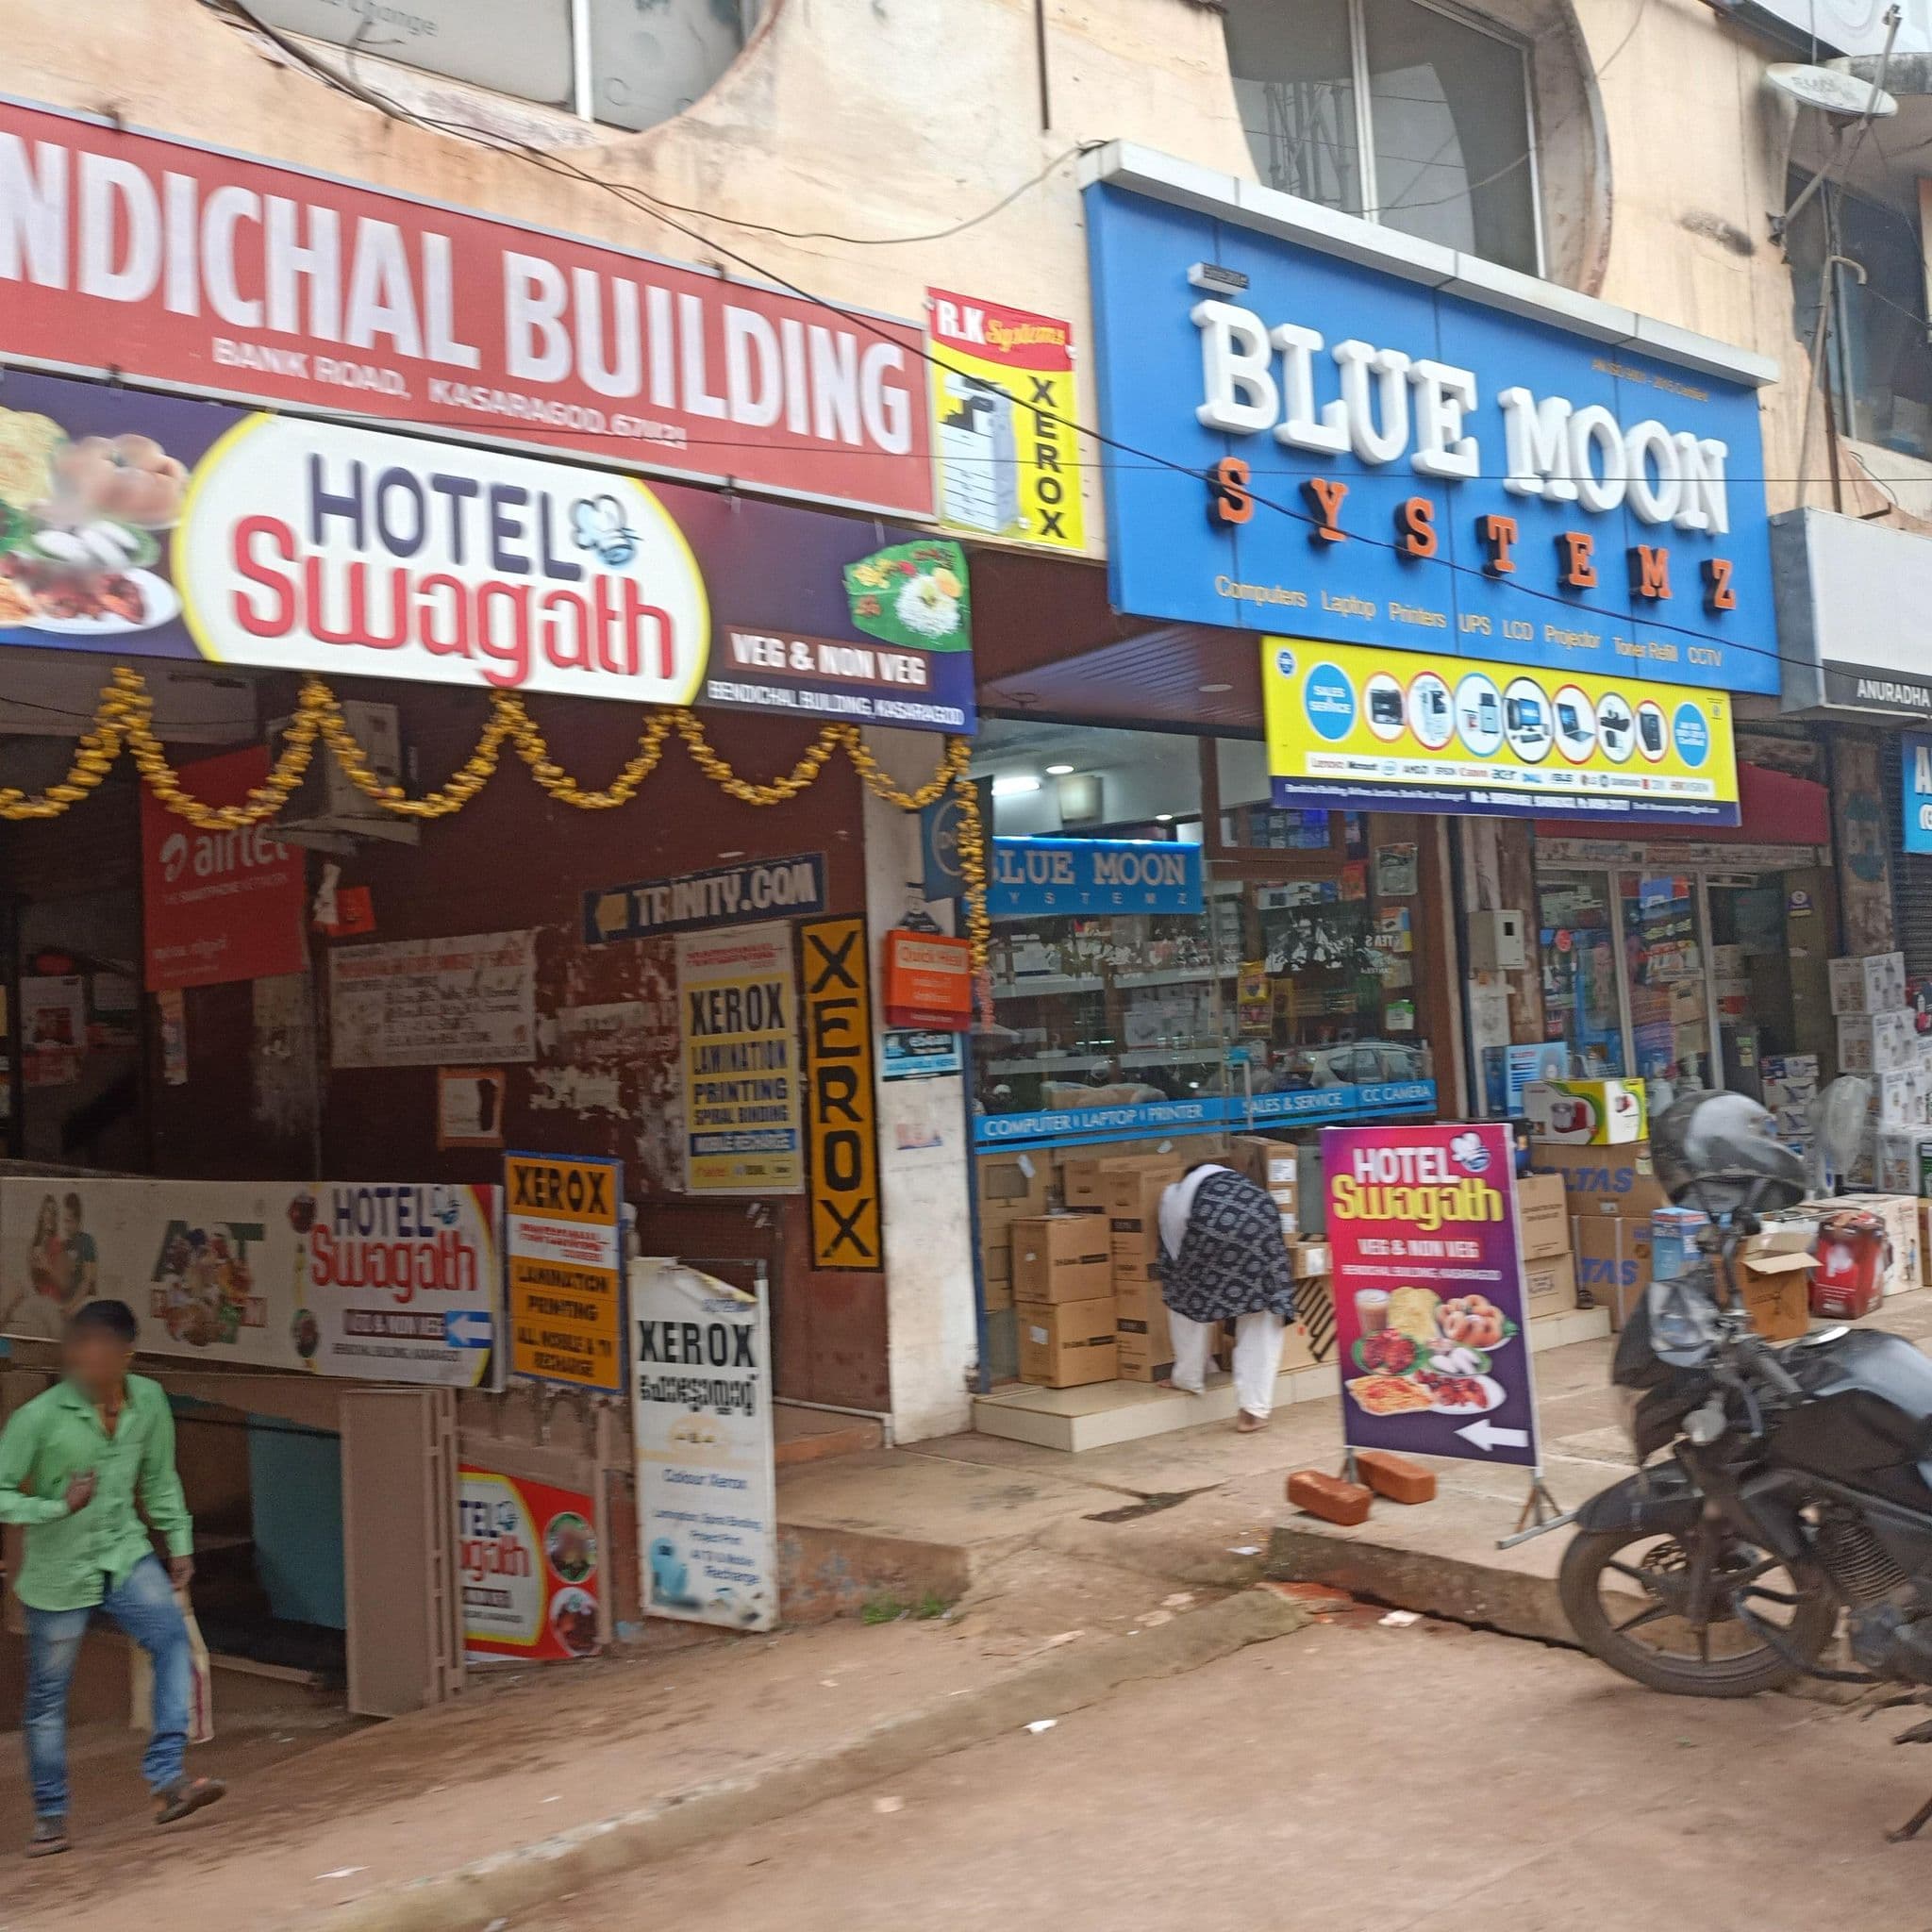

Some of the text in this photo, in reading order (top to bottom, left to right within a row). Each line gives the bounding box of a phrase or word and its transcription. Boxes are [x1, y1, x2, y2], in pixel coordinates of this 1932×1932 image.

[936, 299, 986, 345] R.K
[212, 336, 309, 379] BANK
[314, 356, 412, 400] ROAD,
[503, 251, 911, 456] BUILDING
[1190, 299, 1729, 536] BLUE MOON
[1027, 375, 1069, 540] XEROX
[308, 454, 582, 581] HOTEL
[231, 515, 675, 688] Swagath
[1215, 575, 1722, 667] Computers Laptop Printers UPS LCD Projector Toner Refill CCTV
[730, 633, 926, 686] VEG & NON VEG
[1307, 700, 1352, 714] SERVICE
[1857, 678, 1930, 708] ANURADHA
[992, 850, 1186, 886] LUE MOON
[691, 983, 785, 1036] XEROX
[693, 1078, 787, 1105] PRINTING
[807, 931, 875, 1257] XEROX
[1283, 1096, 1293, 1110] &
[1294, 1091, 1342, 1109] SERVICE
[1361, 1086, 1381, 1102] CC
[1384, 1084, 1431, 1101] CAMERA
[984, 1114, 1072, 1136] COMPUTER
[1084, 1109, 1138, 1128] LAPTOP
[1147, 1104, 1204, 1123] PRINTER
[514, 1165, 608, 1214] XEROX
[1353, 1147, 1460, 1184] HOTEL
[333, 1186, 434, 1238] HOTEL
[1331, 1174, 1505, 1231] Swagath
[312, 1224, 477, 1304] Swagath
[1357, 1239, 1480, 1258] VEG & NON VEG
[518, 1264, 608, 1293] LAMINATION
[527, 1294, 598, 1322] PRINTING
[638, 1321, 758, 1368] XEROX
